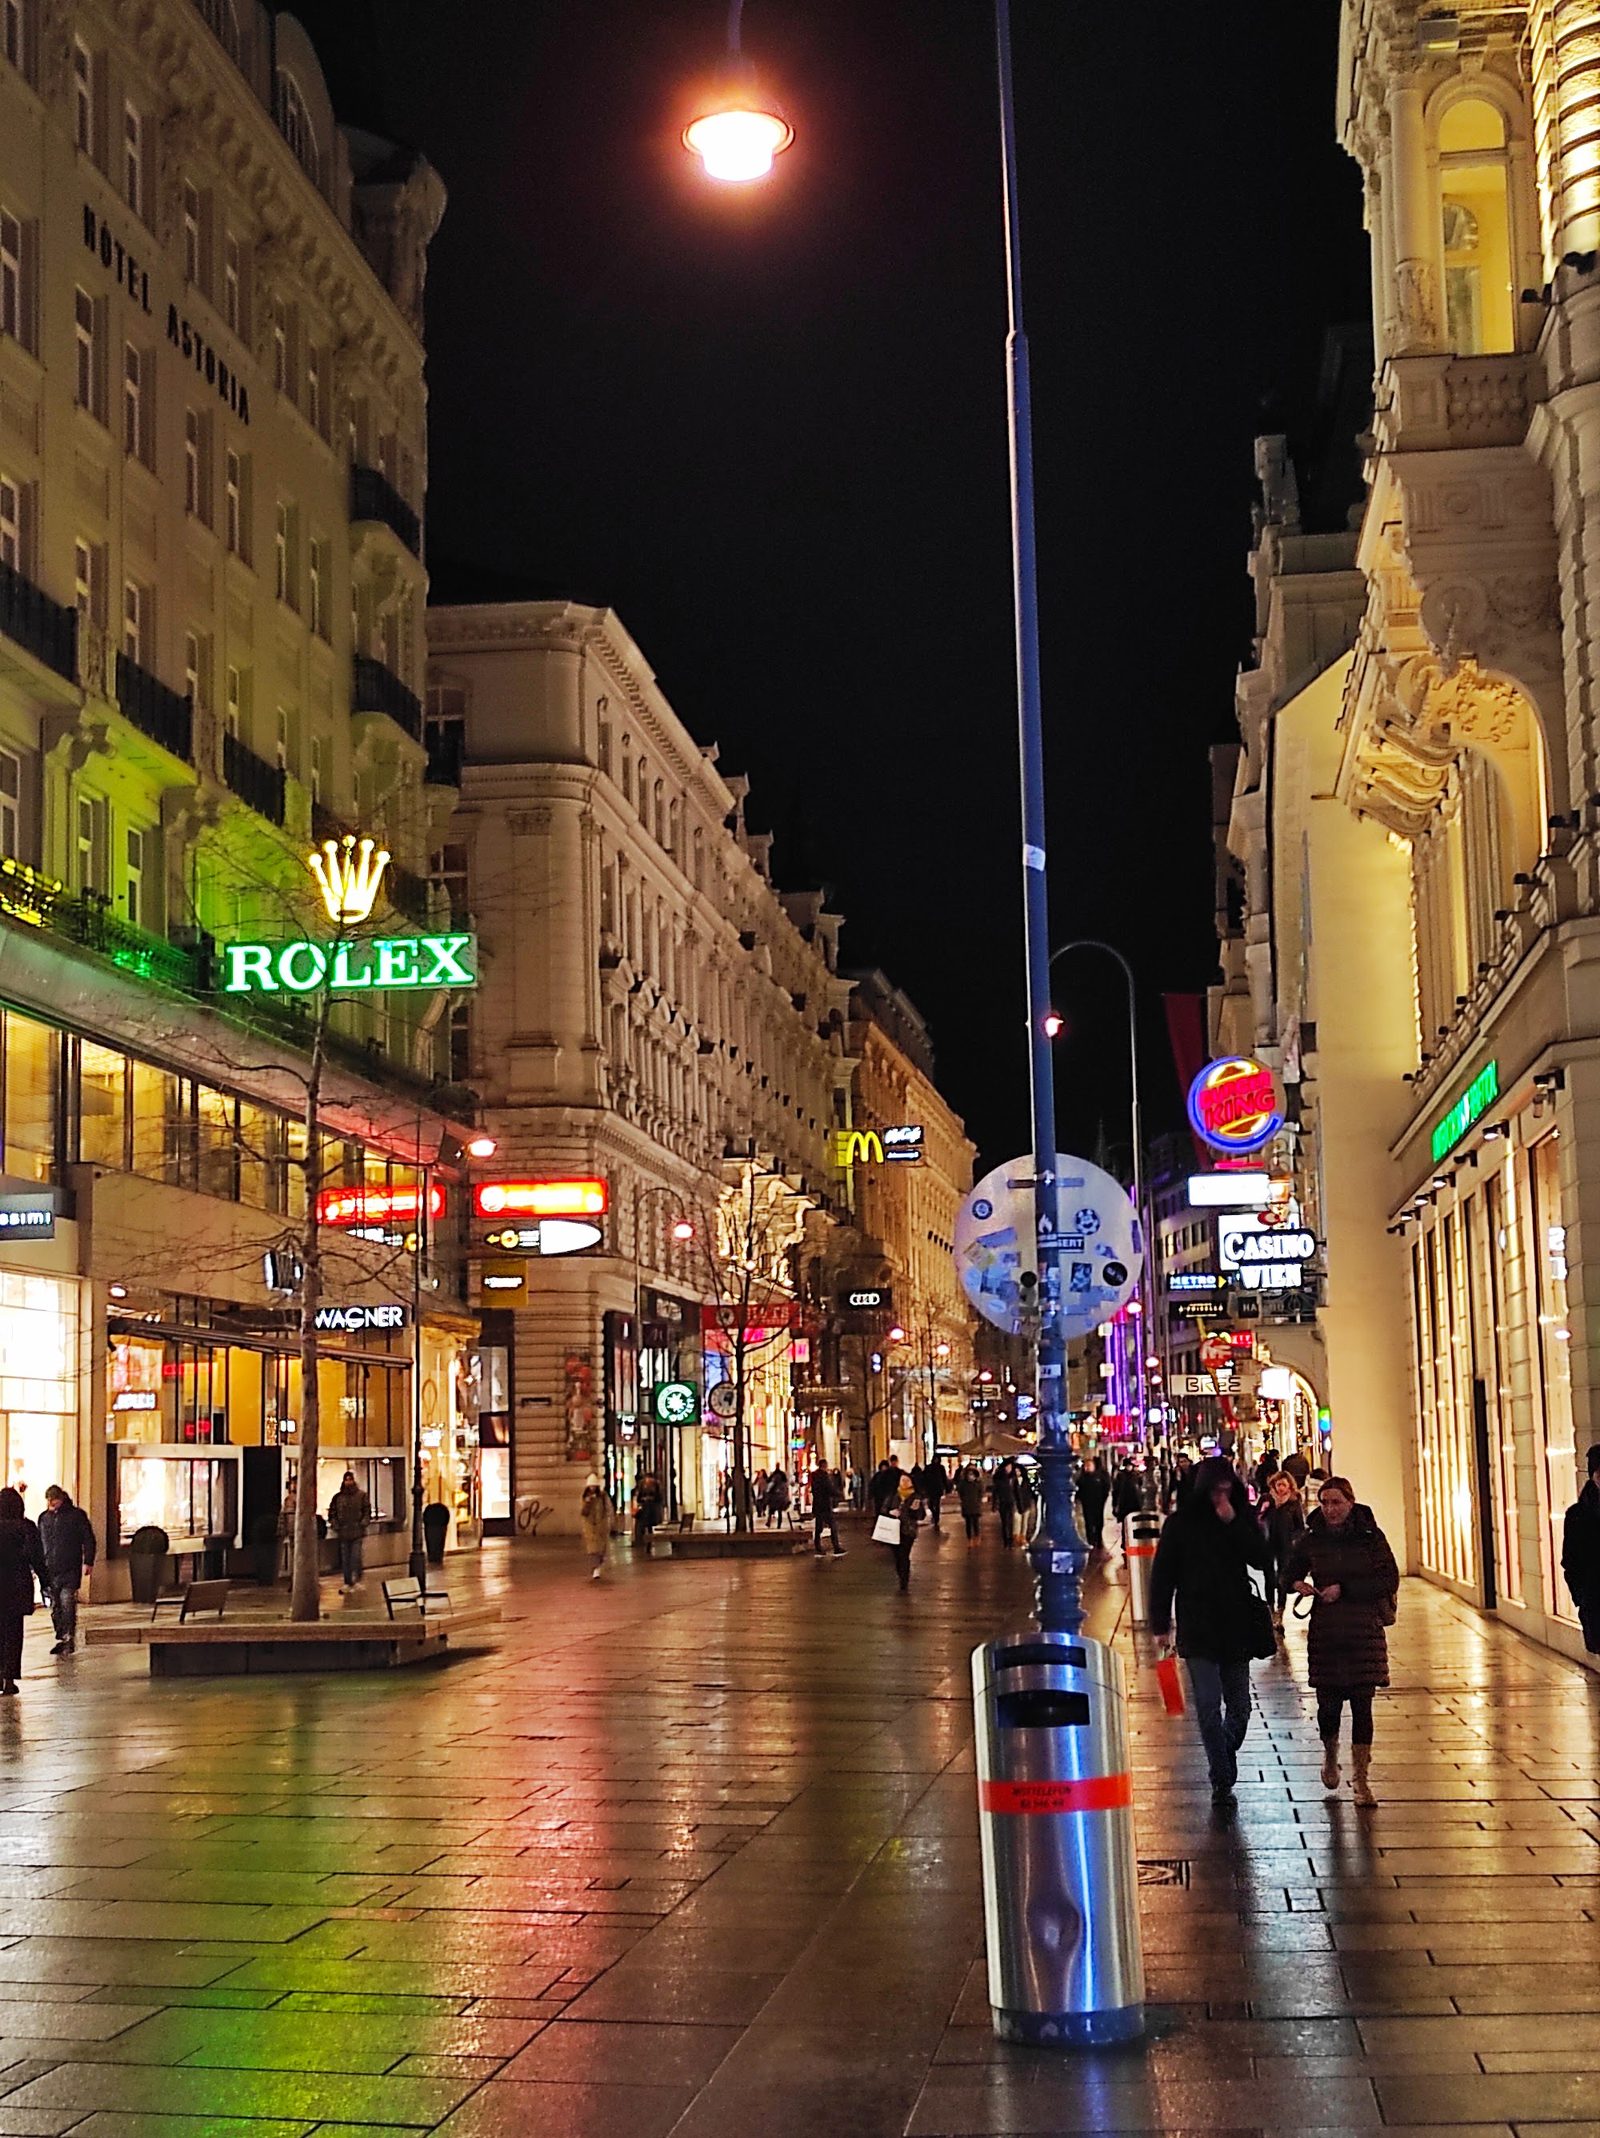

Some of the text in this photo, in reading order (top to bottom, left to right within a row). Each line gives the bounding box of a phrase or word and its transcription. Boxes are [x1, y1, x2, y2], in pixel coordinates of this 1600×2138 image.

[83, 203, 249, 426] HOTEL ASTORIA
[225, 936, 475, 992] ROLEX
[1203, 1087, 1276, 1132] KING
[1169, 1275, 1217, 1285] METRO
[1240, 1263, 1303, 1289] WIEN
[315, 1306, 403, 1330] WAGNER
